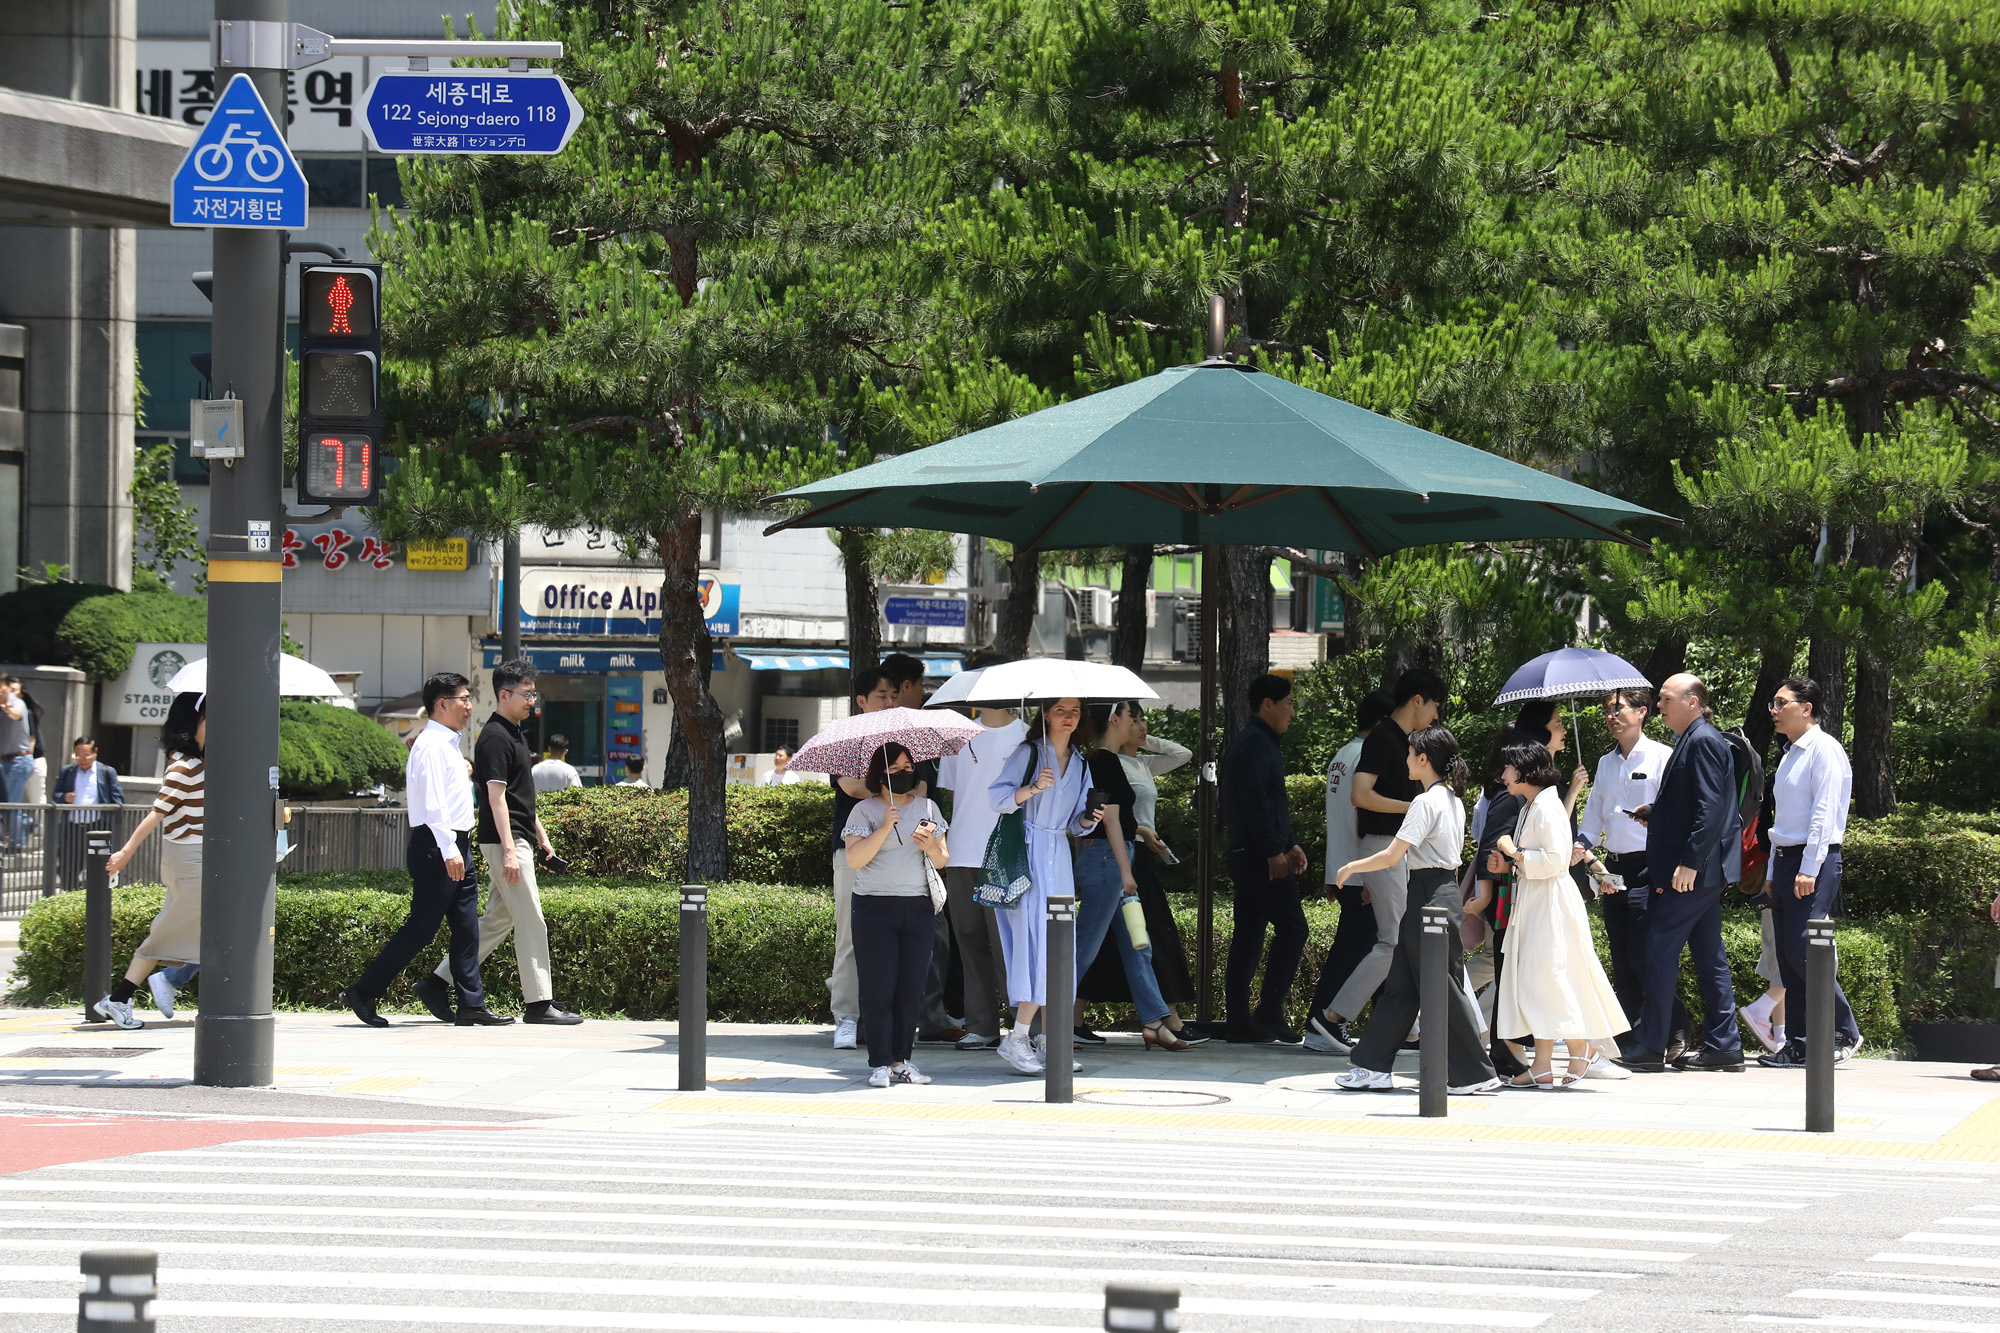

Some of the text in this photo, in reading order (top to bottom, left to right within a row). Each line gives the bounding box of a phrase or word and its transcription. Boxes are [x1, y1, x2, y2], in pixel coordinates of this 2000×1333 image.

[137, 70, 352, 127] 세종역
[426, 81, 514, 106] 세종대로
[382, 104, 556, 128] 122 Sejong-daero 118
[412, 135, 526, 148] 世宗大路 セジョンデロ
[192, 198, 283, 222] 자전거횡단
[321, 438, 369, 490] 71
[254, 537, 267, 549] 13
[544, 584, 613, 610] Office
[124, 693, 176, 705] STARB
[140, 706, 168, 718] COF
